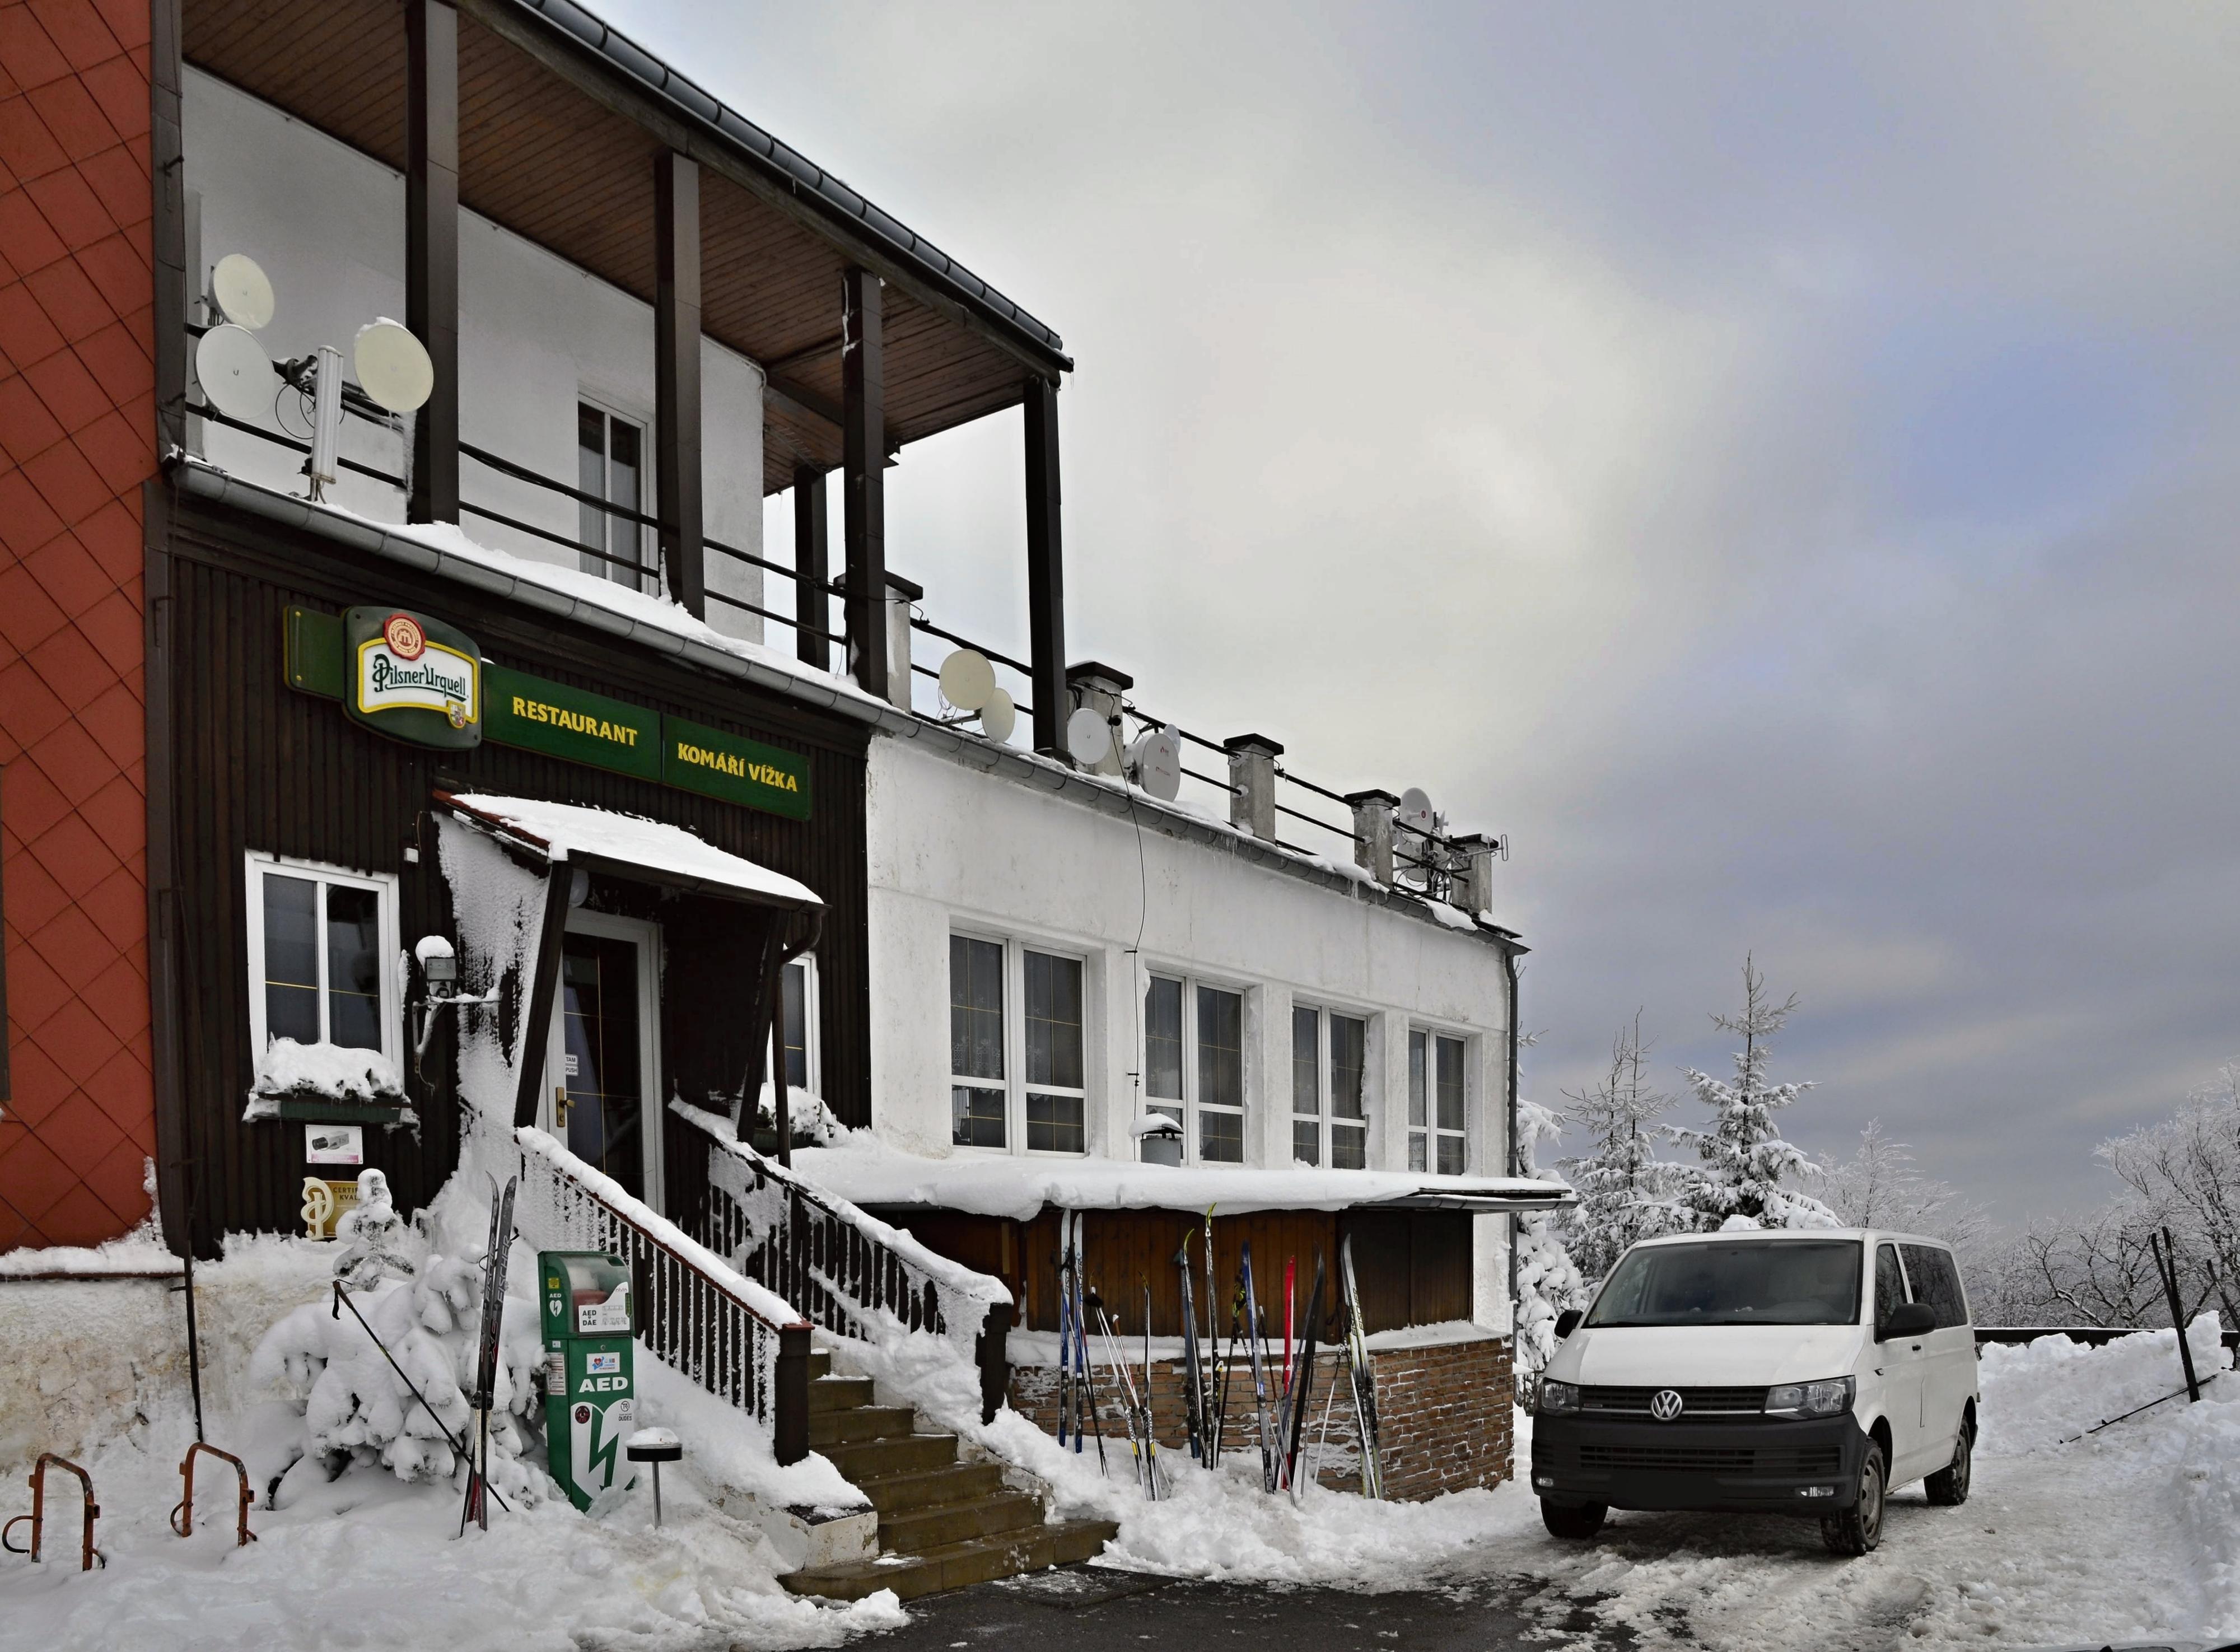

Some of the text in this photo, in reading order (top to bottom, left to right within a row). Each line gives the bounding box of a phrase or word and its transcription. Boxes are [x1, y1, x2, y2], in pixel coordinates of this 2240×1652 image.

[372, 654, 466, 698] Pilsner Urquell
[512, 697, 637, 746] RESTAURANT
[678, 742, 797, 792] KOMÁŘÍ VÍŽKA
[497, 1234, 511, 1303] FISCHER
[1353, 1287, 1364, 1331] FISCHER
[578, 1376, 628, 1393] AED
